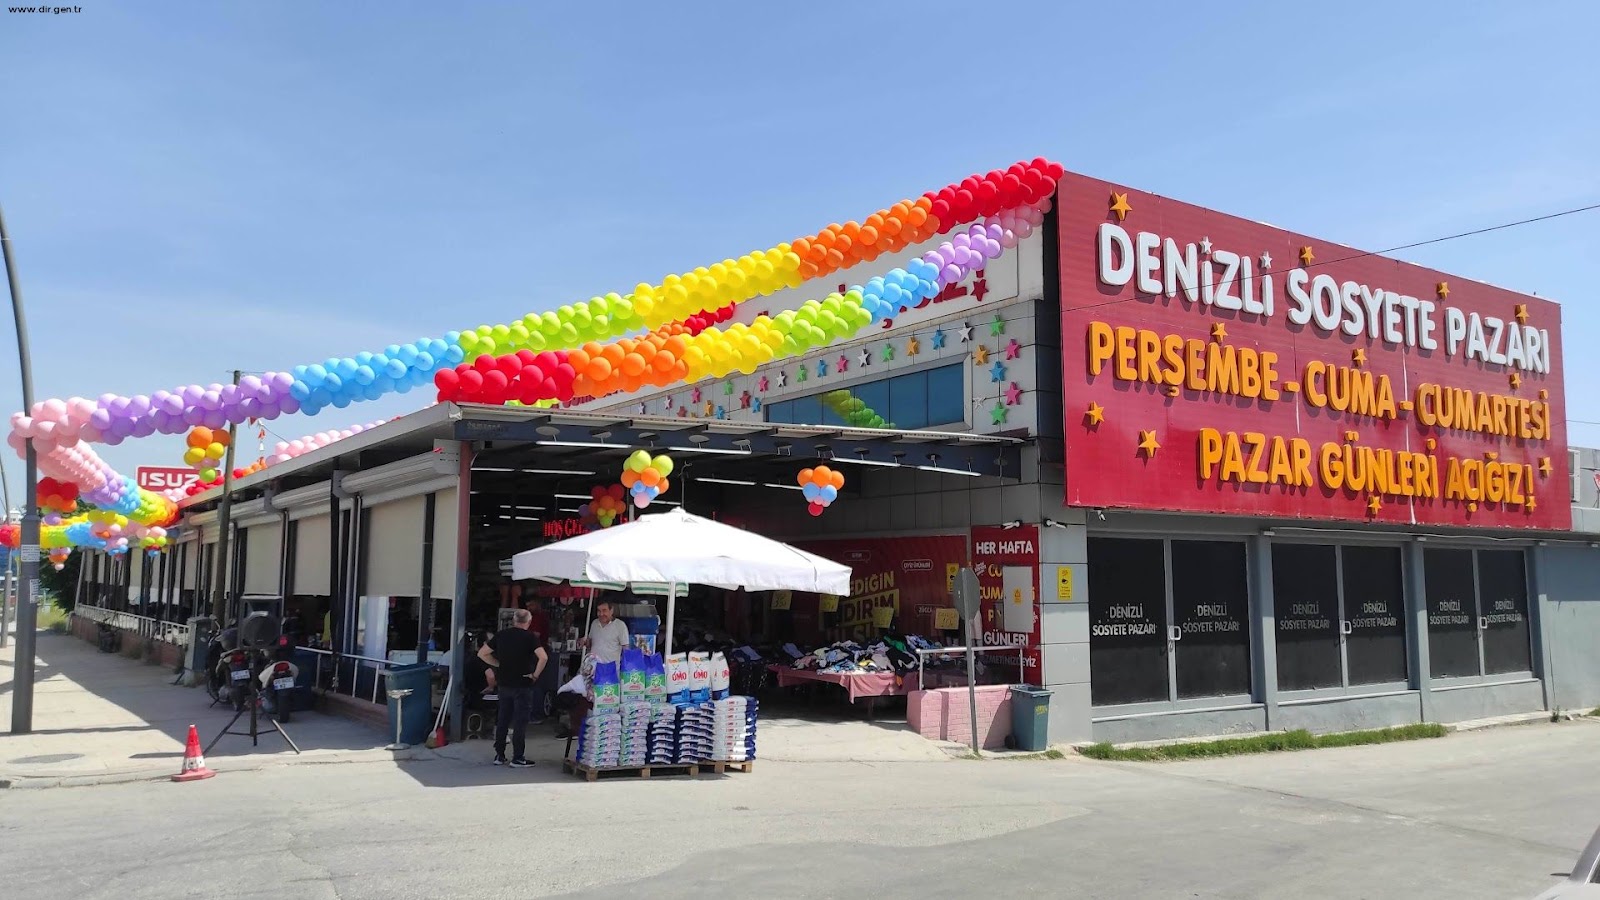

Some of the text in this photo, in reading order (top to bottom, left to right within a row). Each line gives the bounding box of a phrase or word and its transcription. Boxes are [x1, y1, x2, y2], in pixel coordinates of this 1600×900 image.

[1099, 222, 1550, 375] DENİZLİ SOSYETE PAZARI
[1089, 321, 1280, 402] PERŞEMBE
[1305, 360, 1396, 420] CUMA
[1417, 382, 1551, 441] CUMARTESİ
[1200, 427, 1314, 488] PAZAR
[1320, 431, 1440, 499] GÜNLERİ
[141, 472, 201, 488] ISUZ
[976, 540, 1034, 555] HER HAFTA
[1109, 603, 1143, 619] DENİZLİ
[1197, 602, 1228, 617] DENİZLİ
[1092, 620, 1156, 636] SOSYETE PAZARI
[1182, 618, 1240, 633] SOSYETE PAZARI
[1280, 616, 1330, 630] SOSYETE PAZARI
[1352, 616, 1376, 628] SOSYETE
